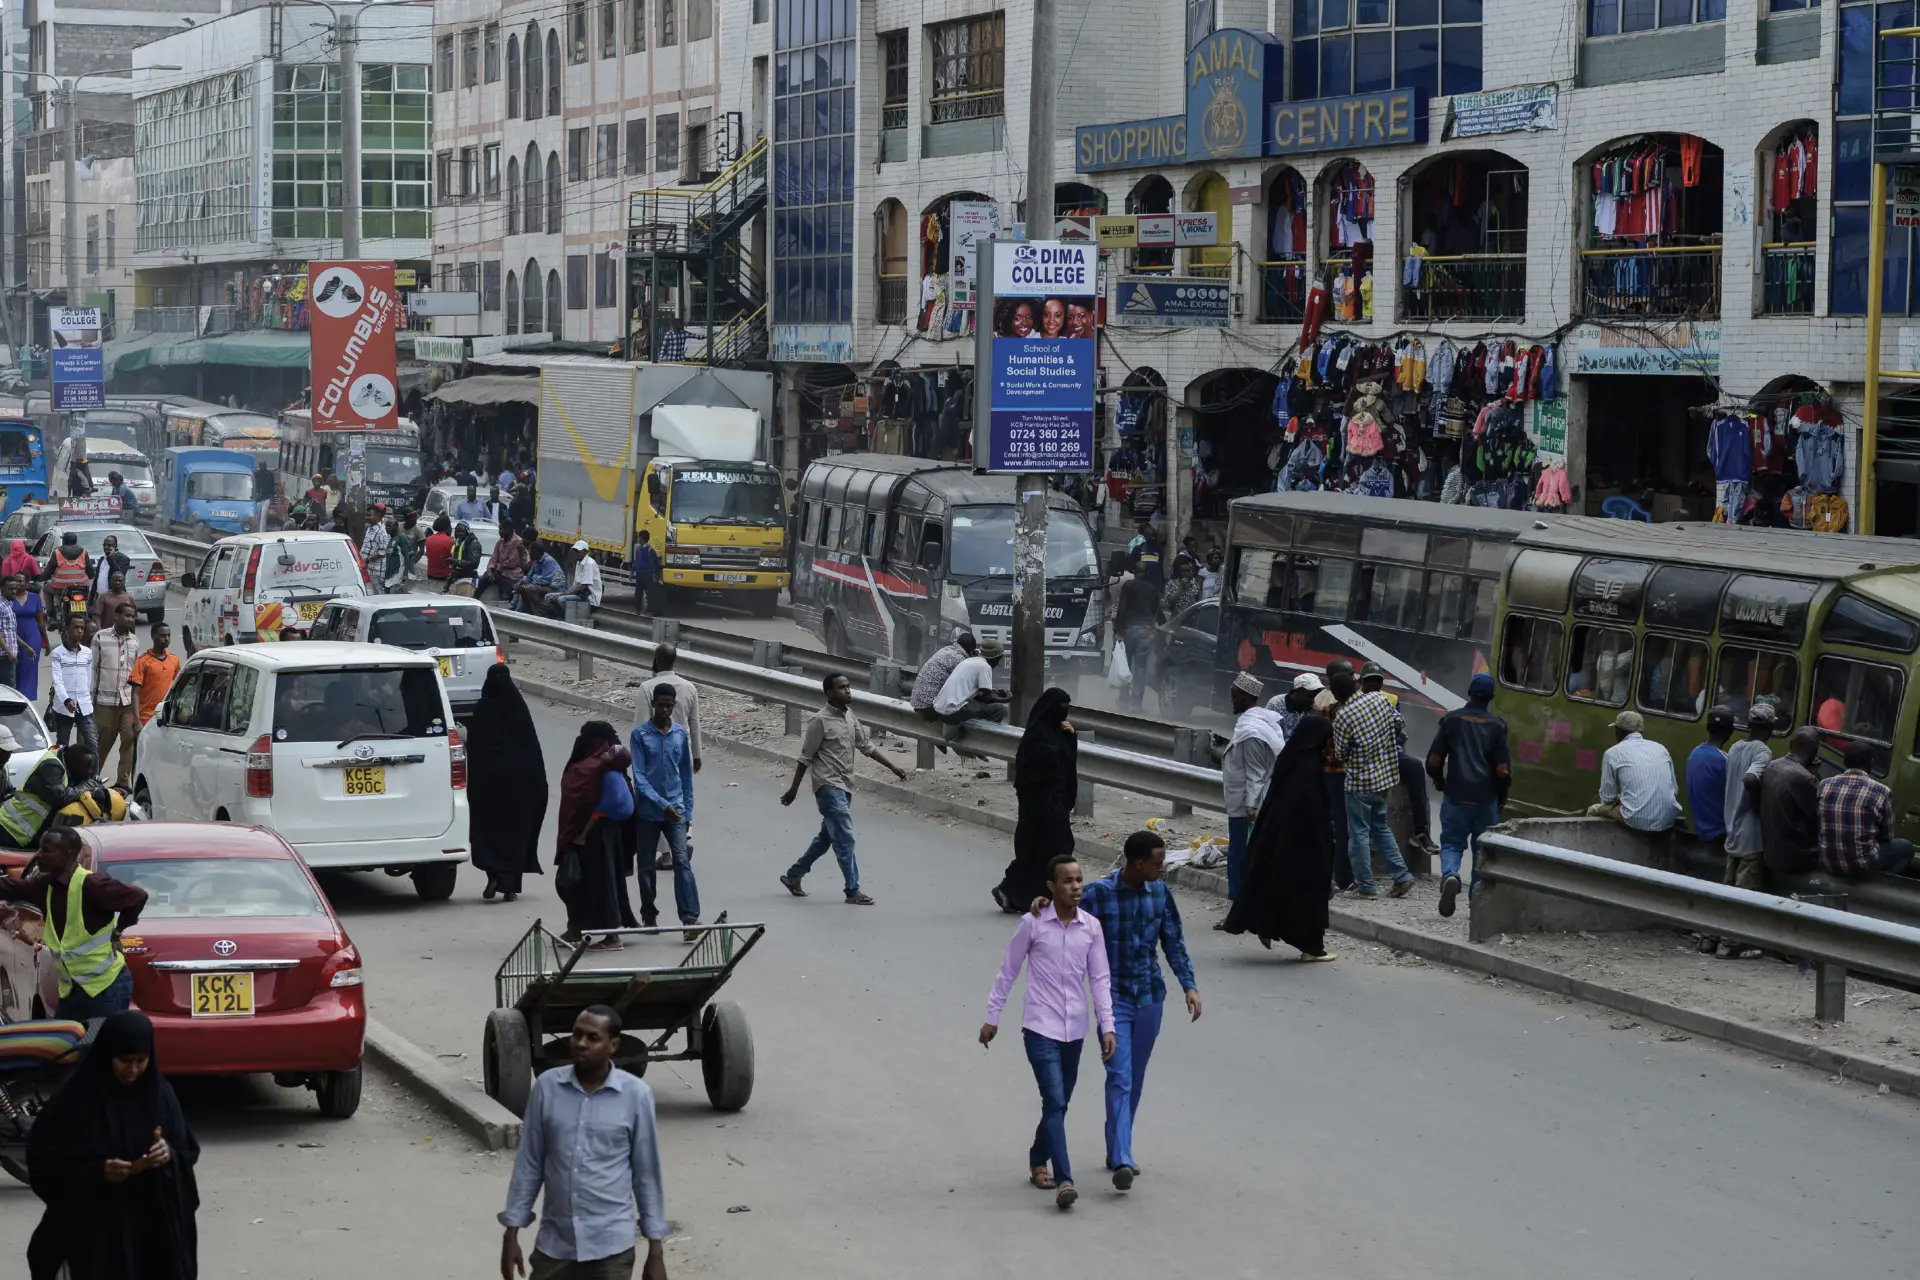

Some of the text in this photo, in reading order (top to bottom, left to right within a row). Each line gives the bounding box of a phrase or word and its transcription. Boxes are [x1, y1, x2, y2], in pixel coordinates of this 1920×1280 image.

[1191, 35, 1260, 88] AMAL
[1214, 76, 1235, 88] PLAZA
[1080, 95, 1410, 167] SHOPPING CENTRE
[1177, 217, 1208, 227] XPRESS
[1186, 225, 1214, 234] MONEY
[1041, 248, 1085, 265] DIMA
[1012, 266, 1085, 284] COLLEGE
[1164, 300, 1228, 309] AMAL EXPRESS
[74, 308, 97, 316] DIMA
[60, 316, 97, 325] COLLEGE
[317, 285, 388, 419] COLUMBUS
[1023, 345, 1061, 353] School of
[1009, 355, 1075, 364] Humanities &
[1006, 366, 1076, 376] Social Studies
[1048, 382, 1082, 390] Community
[1010, 429, 1081, 439] 0724 360 244
[1010, 442, 1080, 452] 0736 160 269
[300, 603, 318, 612] KBS
[301, 610, 319, 620] 968
[345, 767, 373, 782] KCE
[346, 781, 382, 795] 890C
[197, 975, 235, 994] KCK
[198, 994, 249, 1012] 212L
